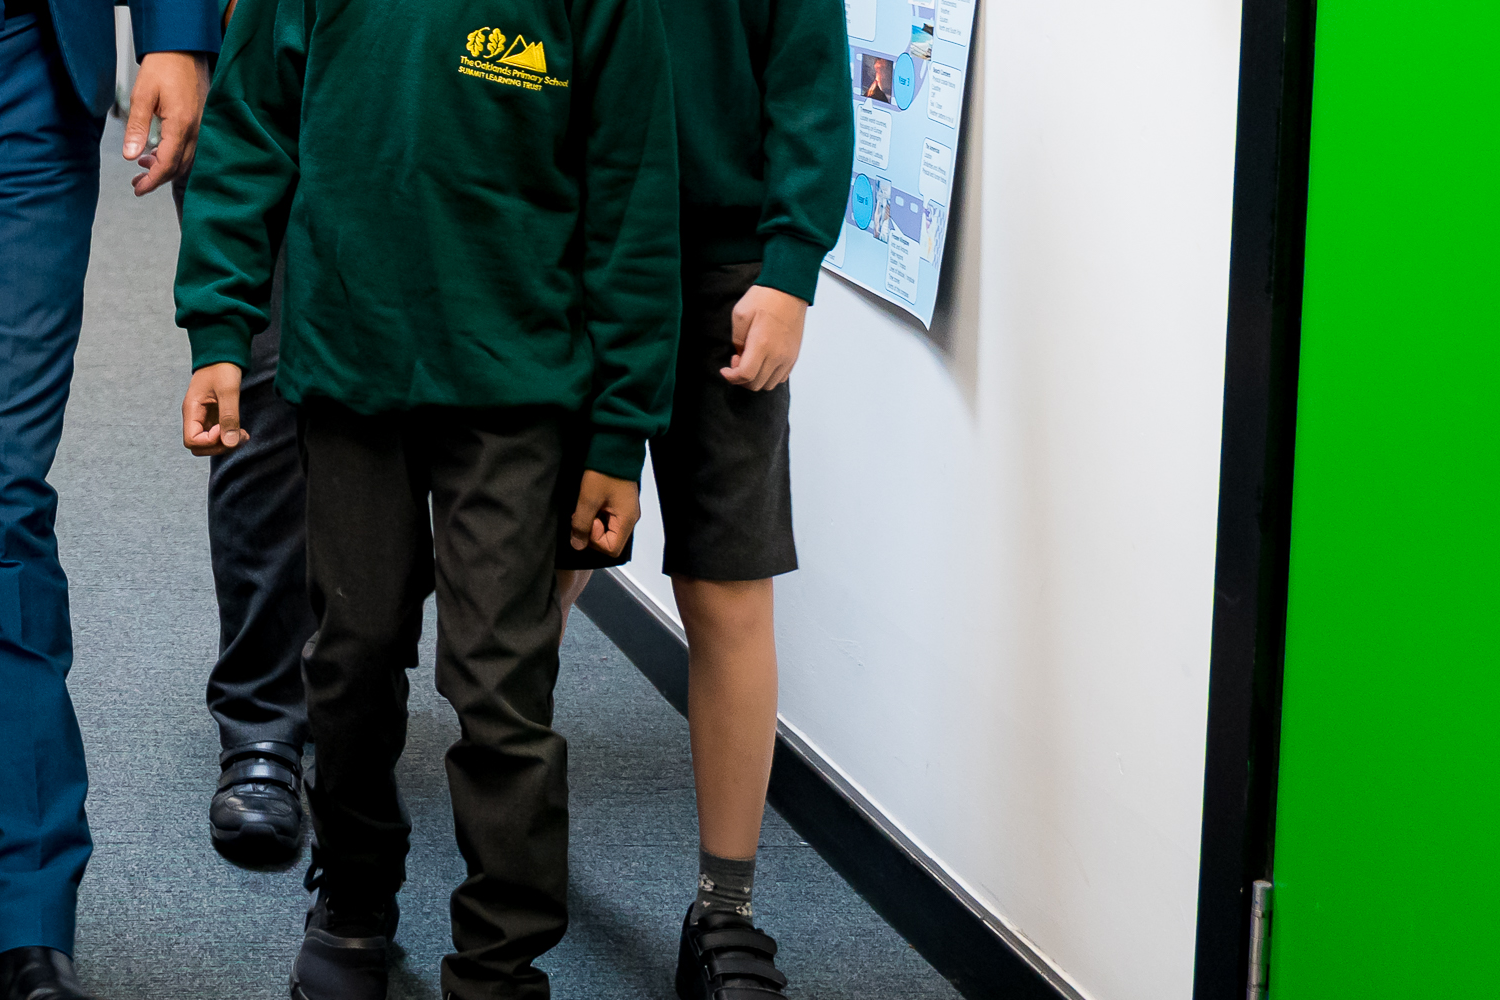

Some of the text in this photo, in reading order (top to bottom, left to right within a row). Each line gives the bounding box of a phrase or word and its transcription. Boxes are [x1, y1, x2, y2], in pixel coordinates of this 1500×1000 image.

[458, 65, 542, 92] SUMMIT LEARNING TRUST
[460, 55, 569, 88] The Oaklands Primary School
